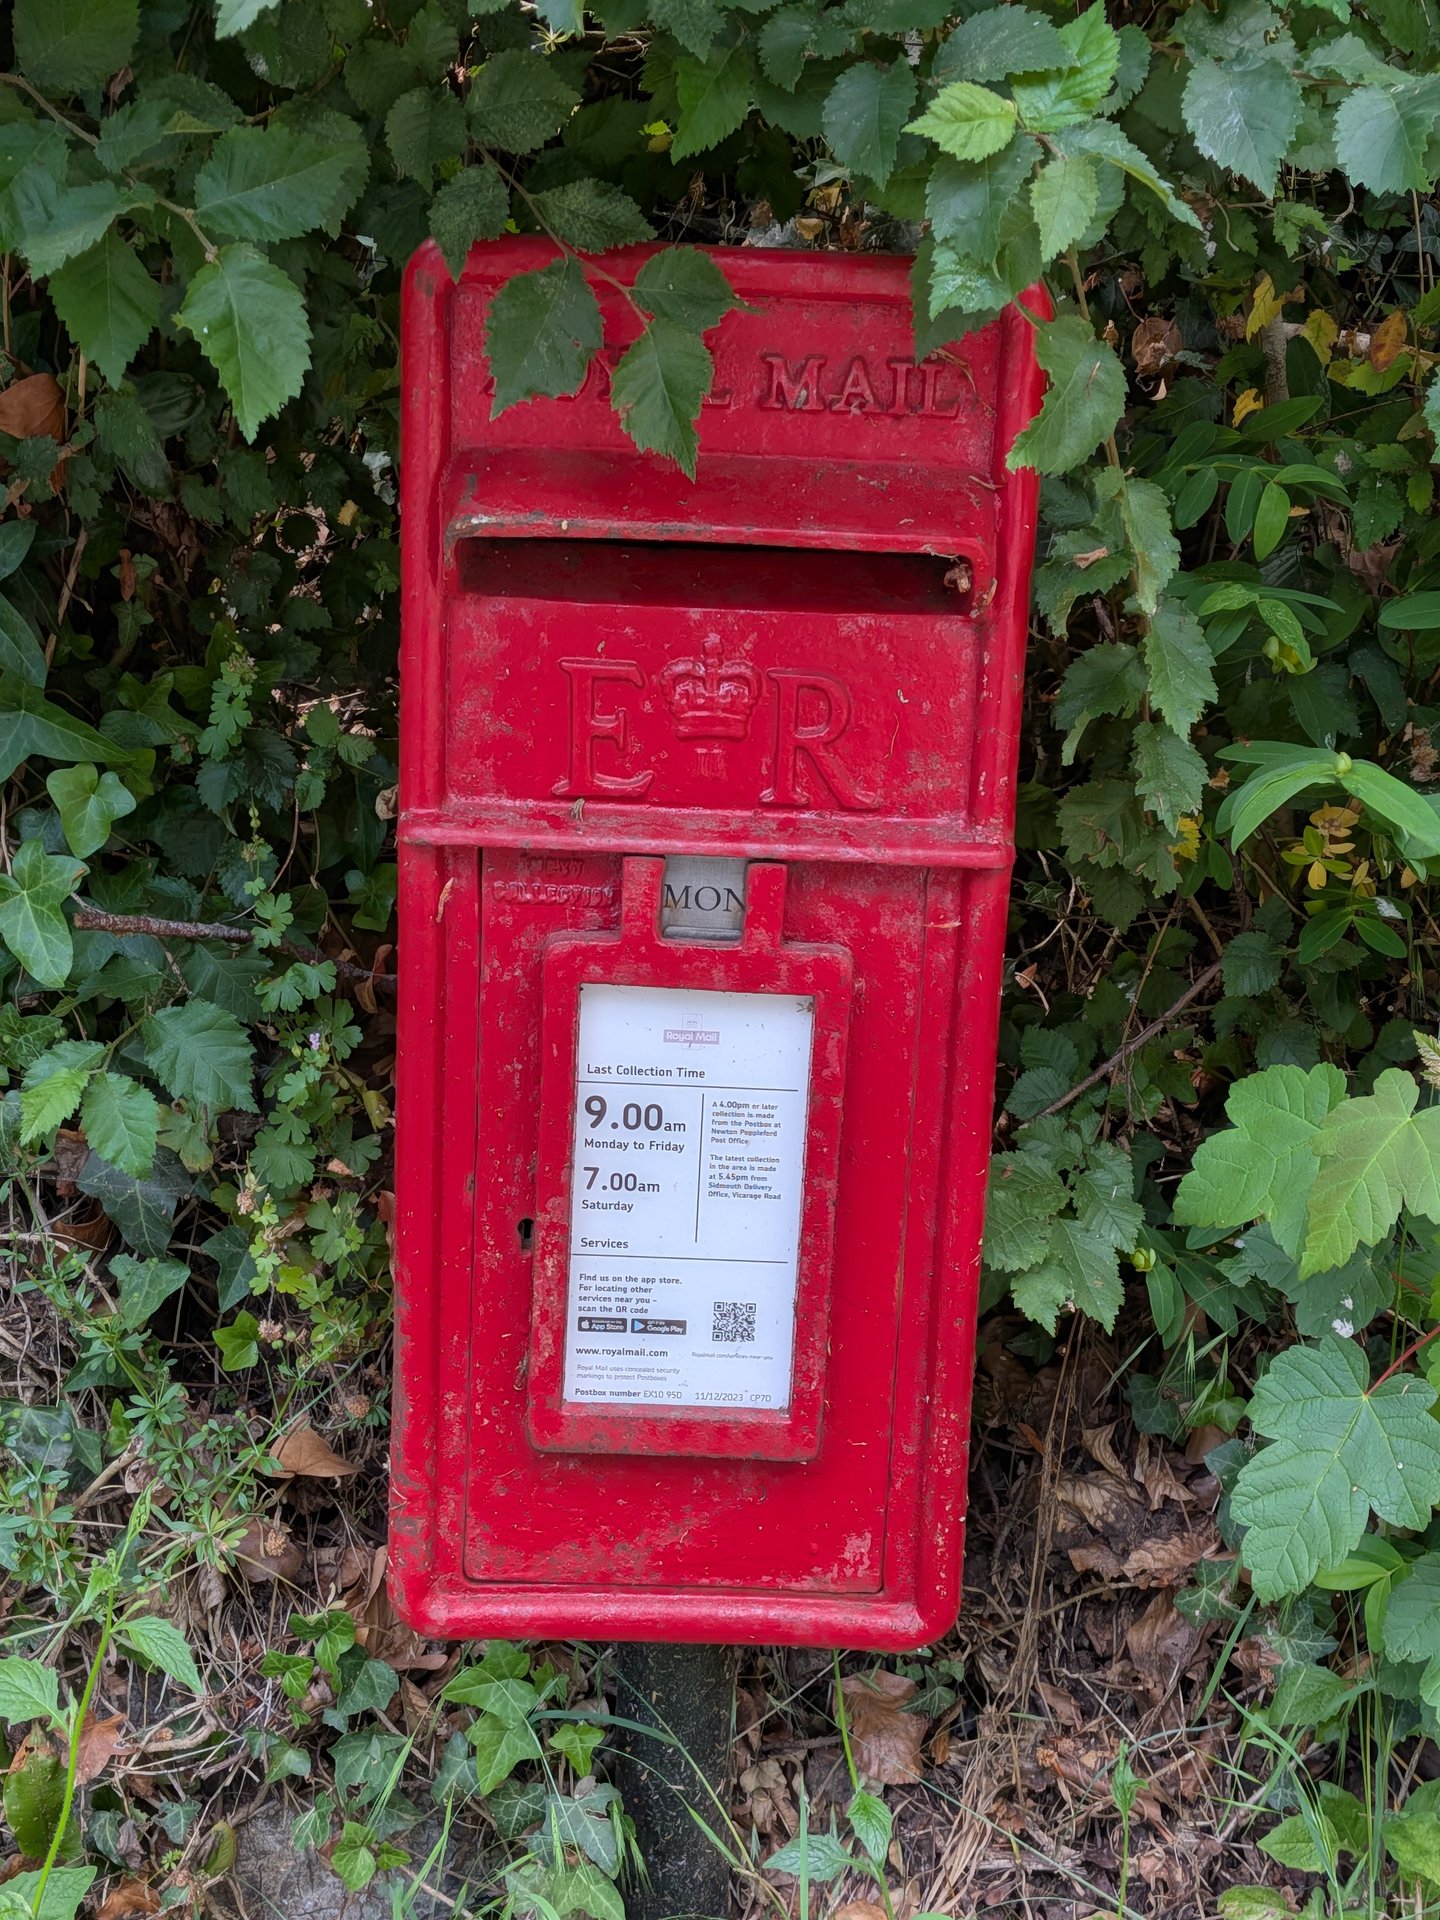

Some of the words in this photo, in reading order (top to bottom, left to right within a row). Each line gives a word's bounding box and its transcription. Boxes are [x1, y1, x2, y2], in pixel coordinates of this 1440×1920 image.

[759, 351, 961, 419] MAIL
[552, 656, 656, 798] E
[759, 666, 883, 811] R
[663, 882, 746, 913] MON
[666, 1031, 694, 1042] Royal
[695, 1032, 717, 1042] Mail
[587, 1063, 612, 1075] Last
[616, 1064, 673, 1077] Collection
[676, 1067, 706, 1079] Time
[719, 1101, 750, 1110] 4.00pm
[584, 1094, 686, 1132] 9.00am
[712, 1110, 746, 1118] collection
[744, 1120, 772, 1128] Postbox
[740, 1129, 778, 1137] Poppleford
[710, 1136, 726, 1144] Post
[584, 1138, 630, 1151] Monday
[633, 1140, 645, 1150] to
[649, 1140, 685, 1154] Friday
[583, 1166, 660, 1193] 7.00am
[718, 1172, 749, 1182] 5.45pm
[708, 1181, 742, 1189] Sidmouth
[744, 1183, 773, 1192] Delivery
[708, 1190, 731, 1199] Office,
[731, 1191, 762, 1200] Vicarage
[763, 1192, 782, 1200] Road
[581, 1199, 634, 1213] Saturday
[580, 1237, 629, 1249] Services
[579, 1273, 597, 1281] Find
[625, 1275, 639, 1283] the
[641, 1277, 656, 1285] app
[659, 1277, 683, 1285] store.
[595, 1285, 628, 1294] locating
[635, 1297, 651, 1305] you
[599, 1305, 613, 1313] the
[630, 1306, 649, 1314] code
[591, 1323, 605, 1331] App
[647, 1324, 669, 1333] Google
[670, 1325, 684, 1334] Play
[575, 1347, 669, 1357] www.royalmail.com
[577, 1364, 594, 1372] Royal
[656, 1367, 680, 1375] security
[576, 1373, 605, 1381] markings
[575, 1388, 607, 1396] Postbox
[609, 1389, 641, 1397] number
[643, 1390, 664, 1399] EX10
[695, 1392, 744, 1401] 11/12/2023
